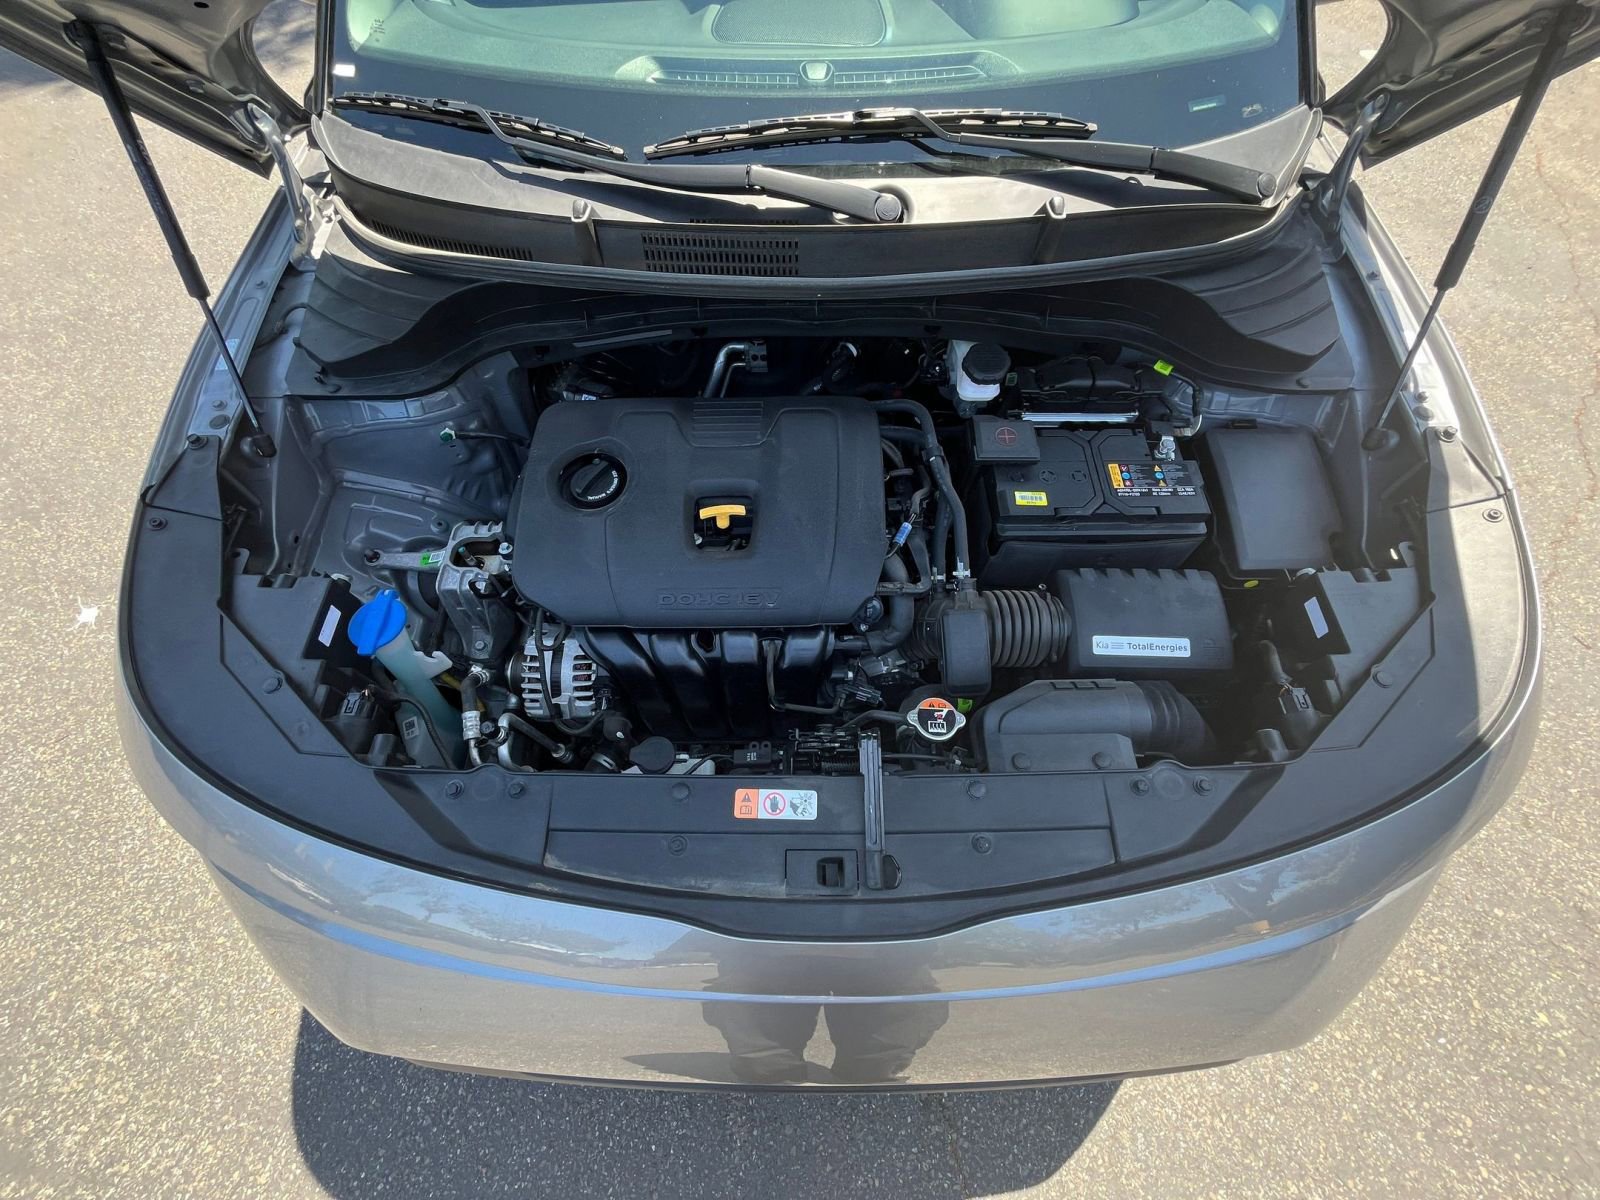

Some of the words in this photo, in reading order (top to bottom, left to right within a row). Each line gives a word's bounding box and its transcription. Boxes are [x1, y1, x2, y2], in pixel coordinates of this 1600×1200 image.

[659, 592, 730, 606] DOHC
[738, 592, 781, 607] 16V
[1096, 640, 1109, 649] Kia
[1127, 642, 1188, 652] TotalEnergies
